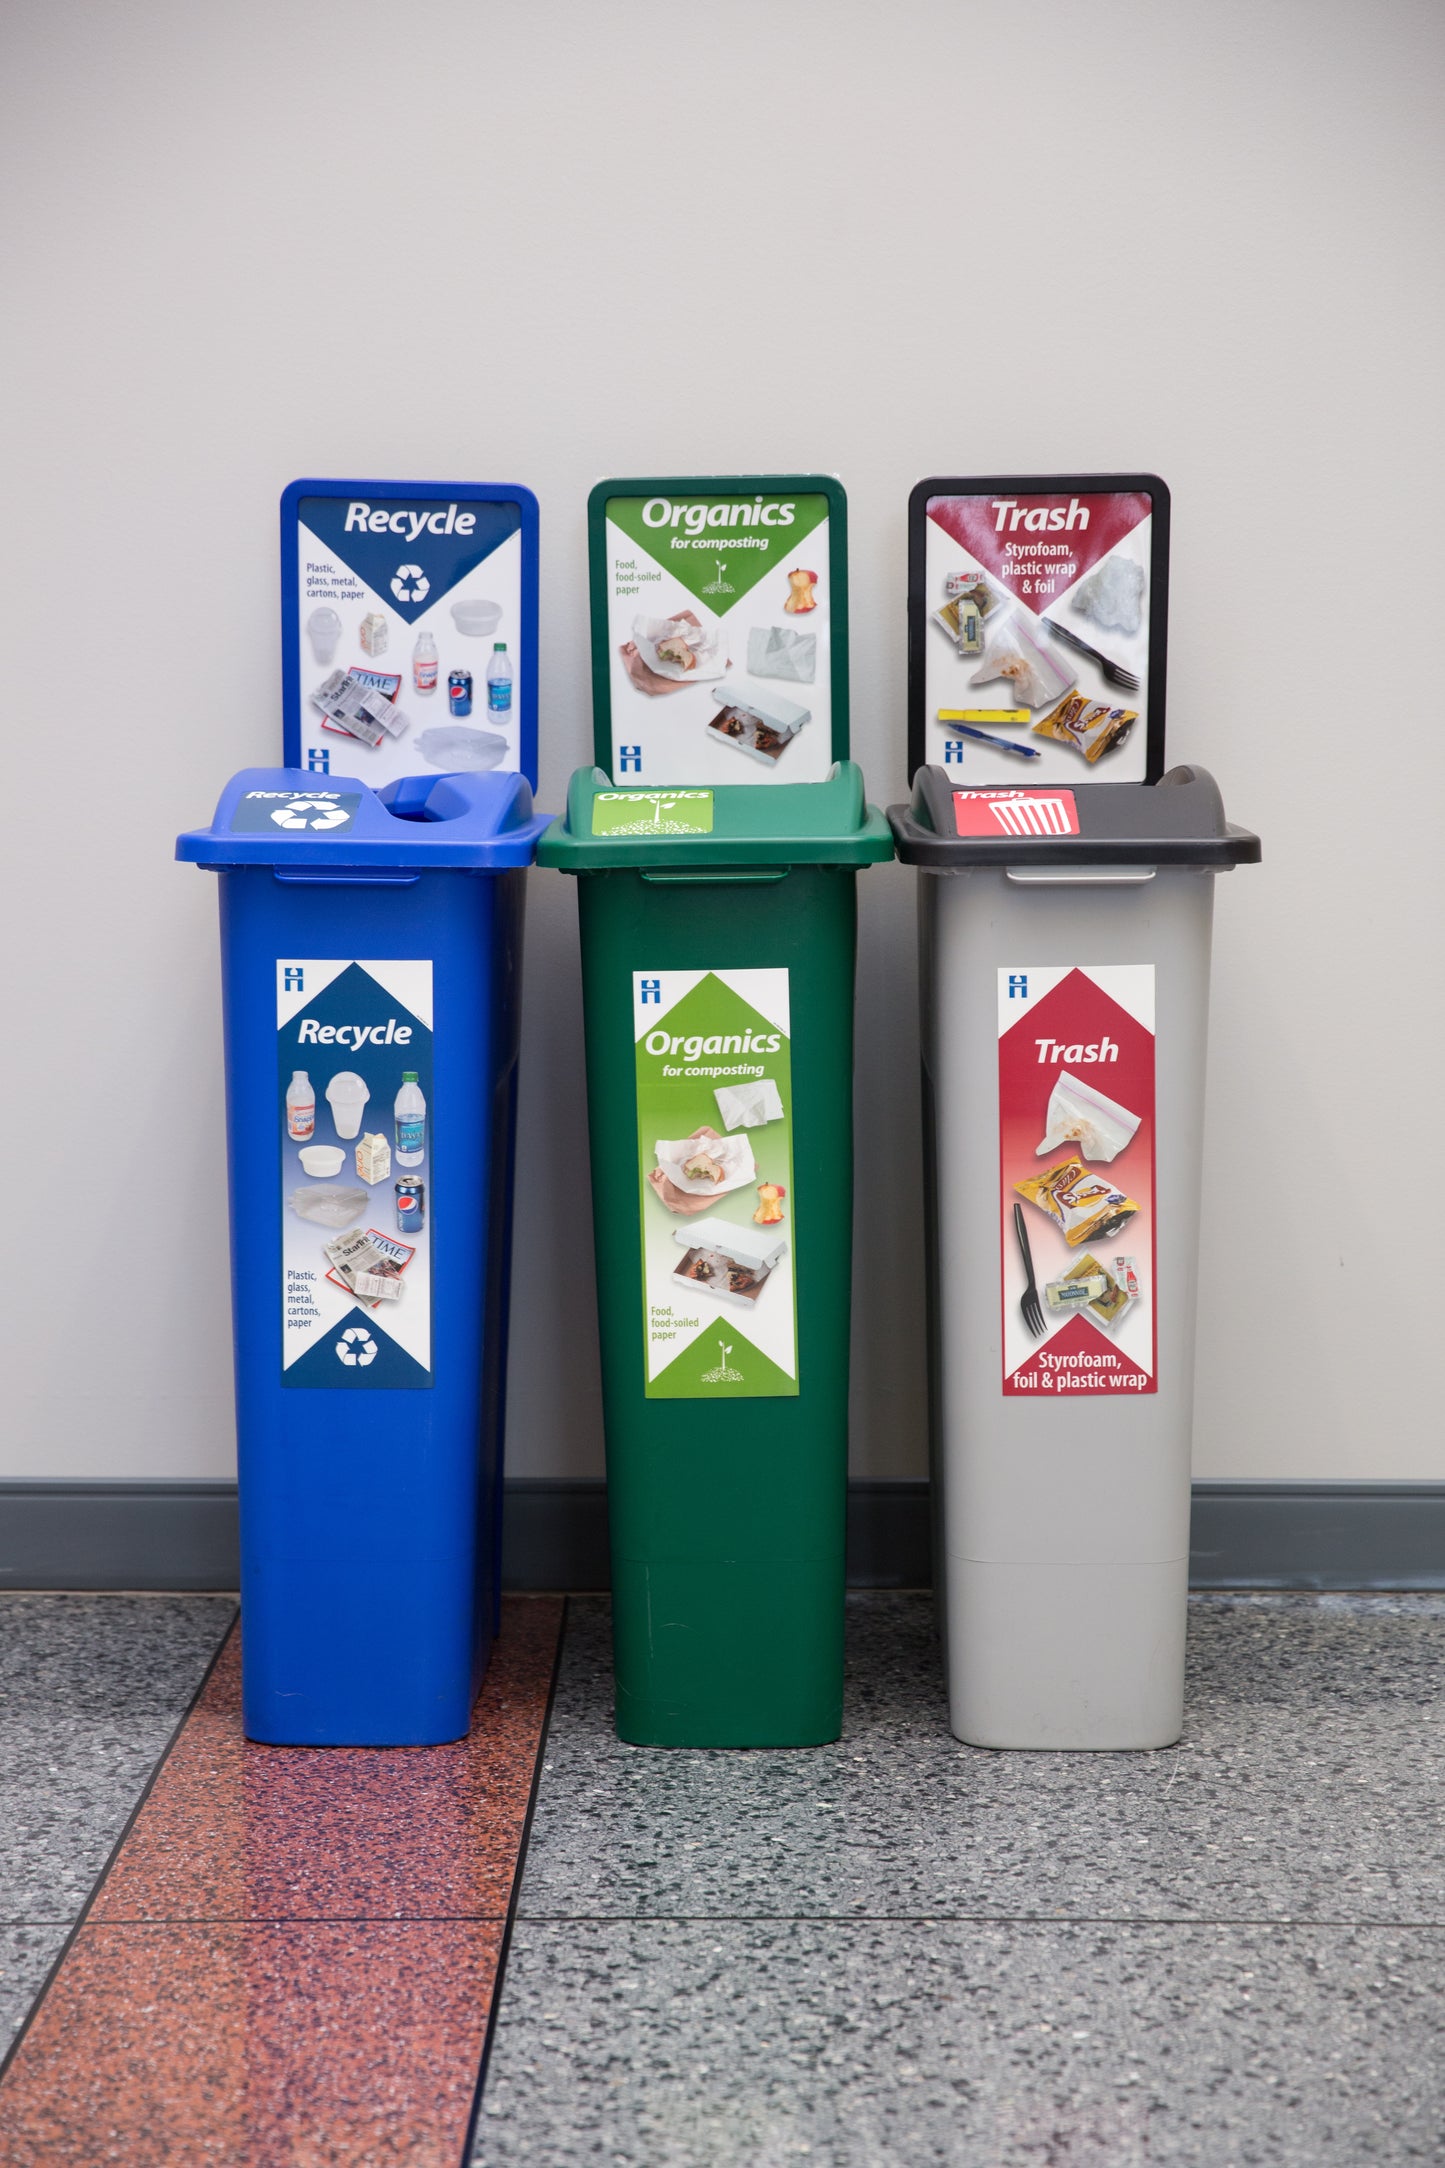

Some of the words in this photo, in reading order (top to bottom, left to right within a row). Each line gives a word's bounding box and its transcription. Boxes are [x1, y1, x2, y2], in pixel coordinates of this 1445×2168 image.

[642, 495, 795, 535] Organics
[991, 498, 1090, 531] Trash
[344, 502, 477, 542] Recycle
[670, 537, 692, 550] for
[692, 536, 769, 550] composting
[1005, 542, 1073, 558] Styrofoam,
[306, 563, 336, 574] Plastic,
[615, 560, 638, 571] Food,
[1002, 561, 1042, 577] plastic
[1045, 563, 1077, 577] wrap
[306, 576, 330, 588] glass,
[331, 577, 358, 588] metal,
[615, 572, 662, 582] food-soiled
[616, 585, 640, 596] paper
[1022, 580, 1033, 594] &
[1034, 579, 1055, 594] foil
[306, 589, 340, 600] cartons,
[340, 590, 365, 600] paper
[357, 672, 392, 691] TIME
[246, 790, 342, 800] Recycle
[597, 790, 710, 802] Organics
[957, 790, 1025, 800] Trash
[297, 1019, 413, 1052] Recycle
[645, 1028, 782, 1062] Organics
[1034, 1037, 1120, 1064] Trash
[662, 1064, 683, 1076] for
[684, 1063, 765, 1078] composting
[371, 1235, 406, 1260] TIME
[287, 1270, 317, 1281] Plastic,
[287, 1282, 310, 1294] glass,
[287, 1294, 314, 1306] metal,
[287, 1307, 320, 1318] cartons,
[651, 1306, 674, 1317] Food,
[287, 1320, 312, 1330] paper
[651, 1318, 700, 1328] food-soiled
[652, 1330, 677, 1341] paper
[1038, 1351, 1122, 1372] Styrofoam,
[1013, 1372, 1038, 1389] foil
[1041, 1373, 1054, 1389] &
[1057, 1372, 1106, 1392] plastic
[1110, 1374, 1148, 1390] wrap
